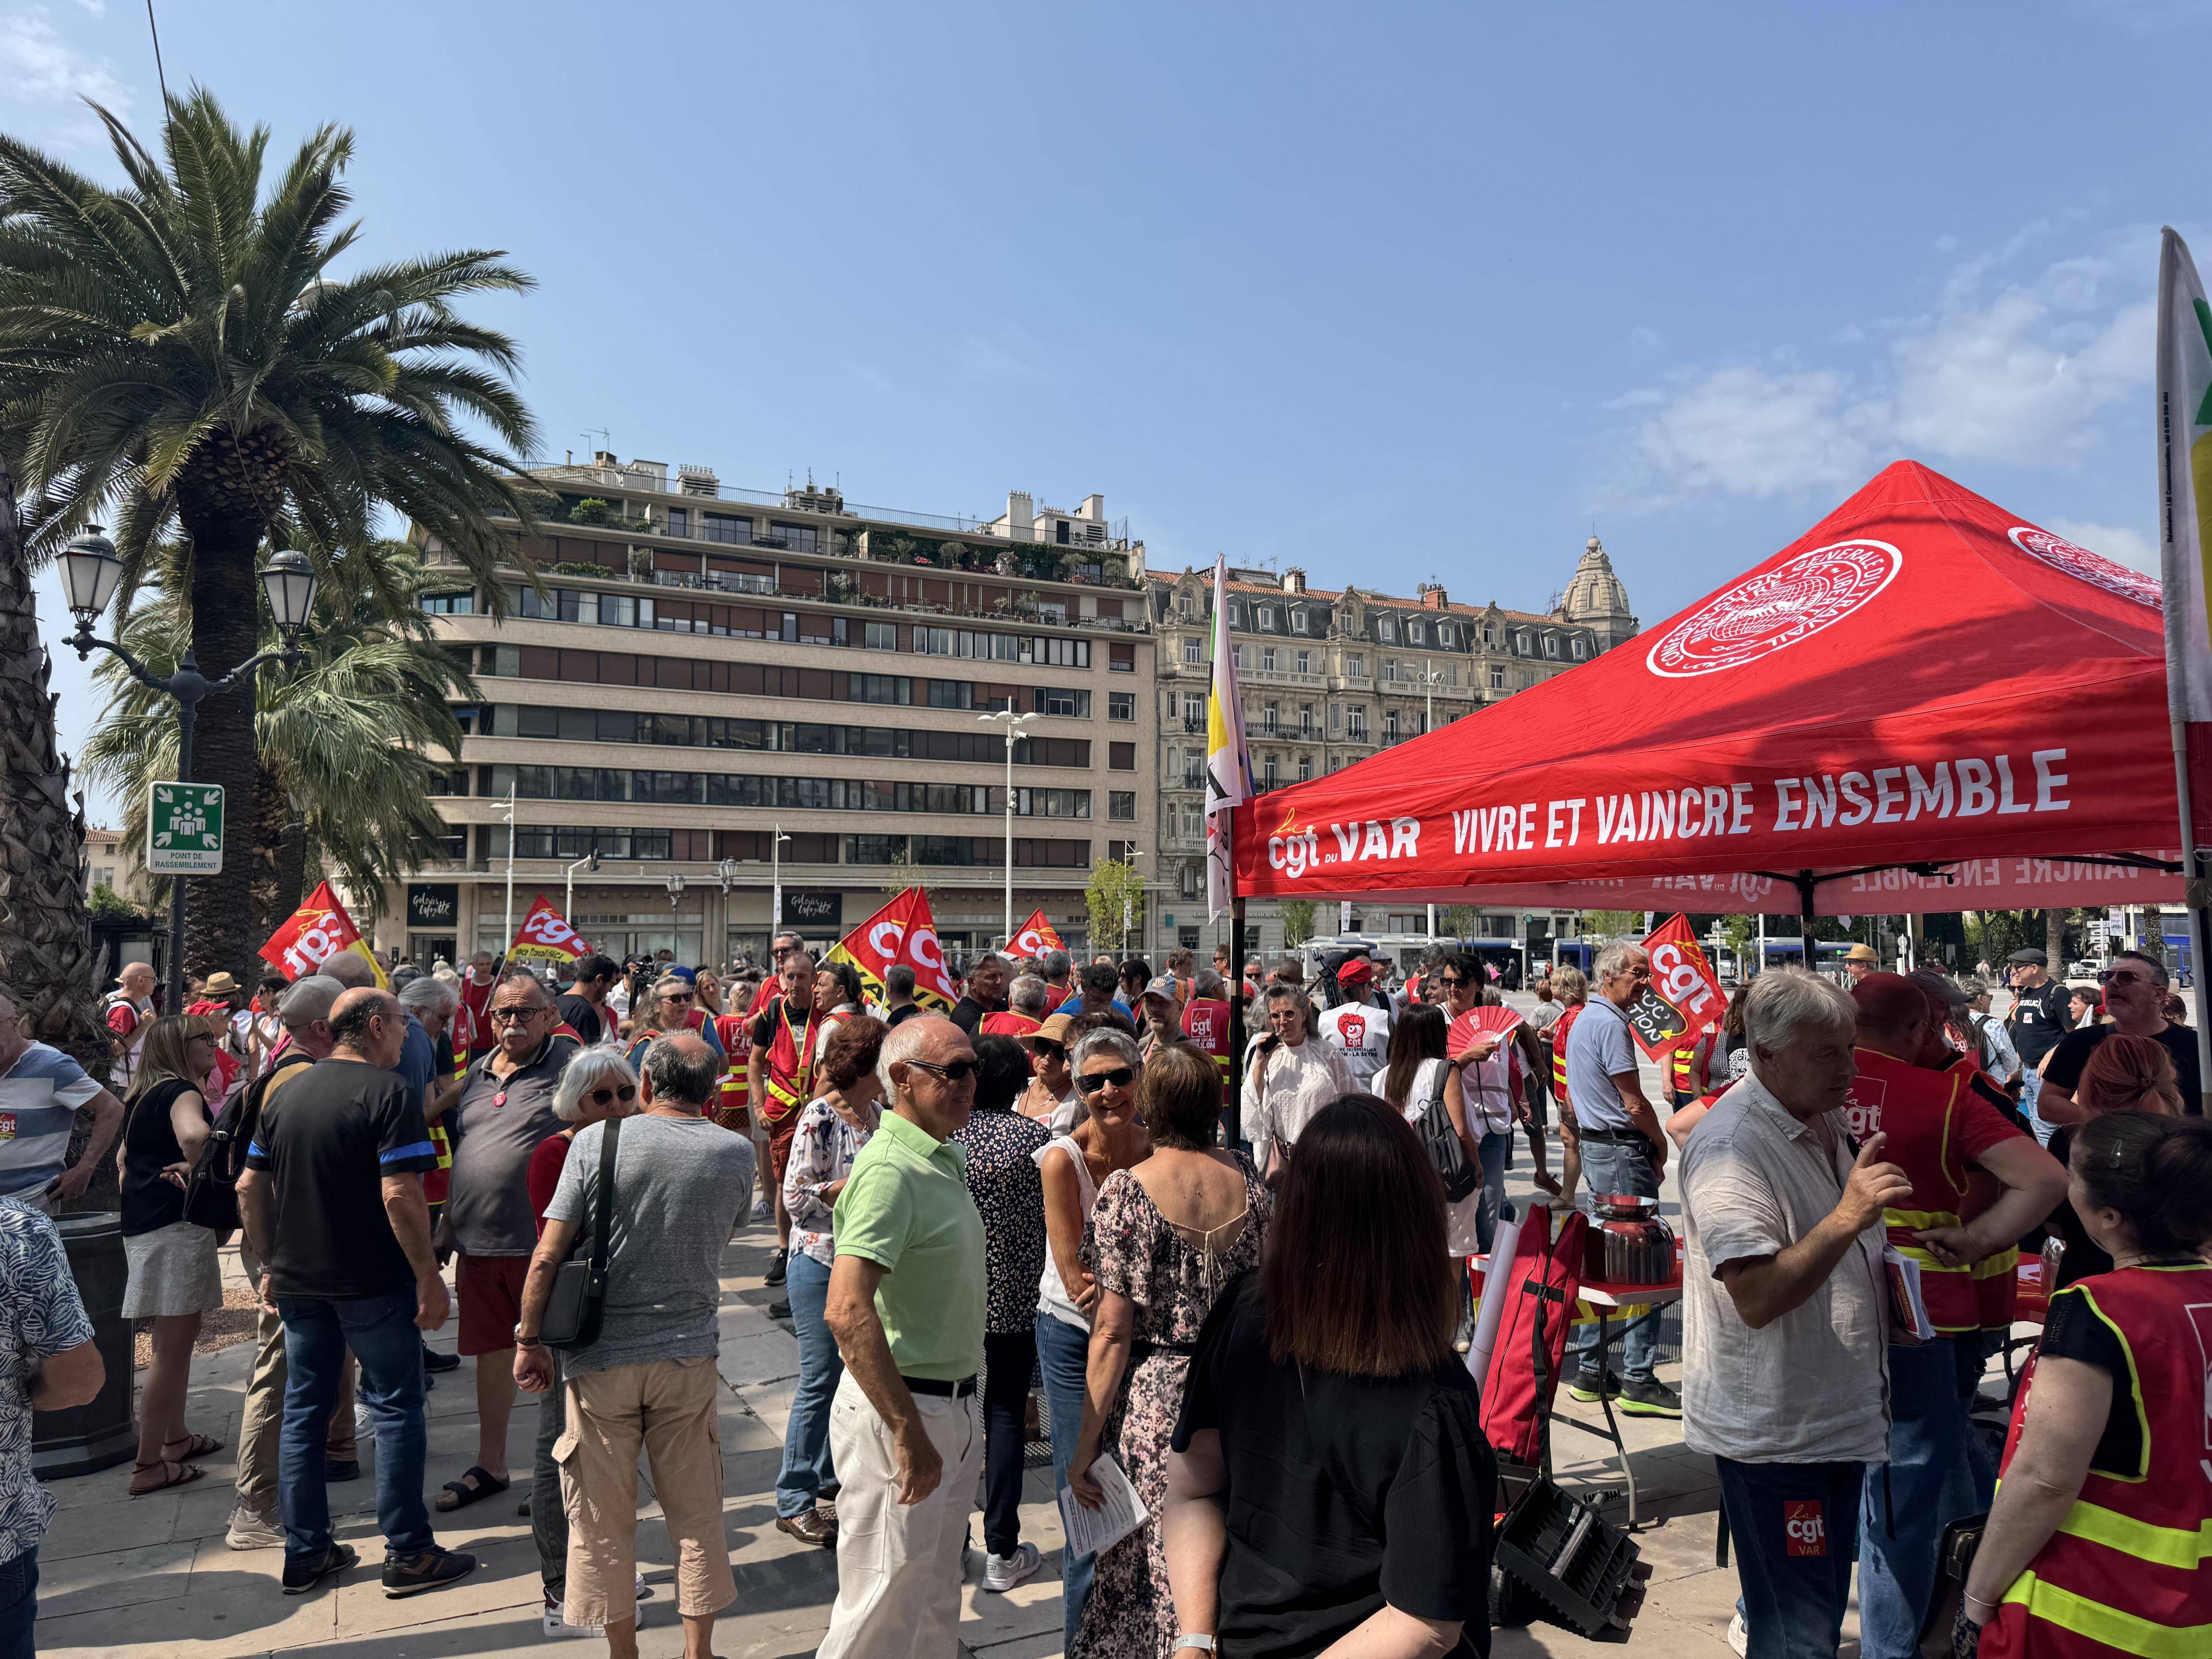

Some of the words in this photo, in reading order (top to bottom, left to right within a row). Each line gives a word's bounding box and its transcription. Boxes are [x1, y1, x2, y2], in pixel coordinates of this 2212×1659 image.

[1791, 548, 1885, 571] GENERALE
[1858, 566, 1885, 587] DU
[1451, 803, 1537, 854] VIVRE
[1544, 798, 1586, 848] ET
[1595, 782, 1754, 845] VAINCRE
[1772, 748, 2071, 832] ENSEMBLE
[1269, 807, 1316, 837] la
[1268, 824, 1320, 879] cgt
[1330, 816, 1421, 862] VAR
[1324, 853, 1338, 864] DU
[1652, 943, 1715, 1014] cgt
[1192, 1018, 1211, 1036] cgt
[1348, 1037, 1361, 1047] cgt
[1842, 1105, 1881, 1135] gt
[1789, 1504, 1822, 1520] la
[1787, 1514, 1824, 1543] cgt
[1798, 1545, 1820, 1556] VAR
